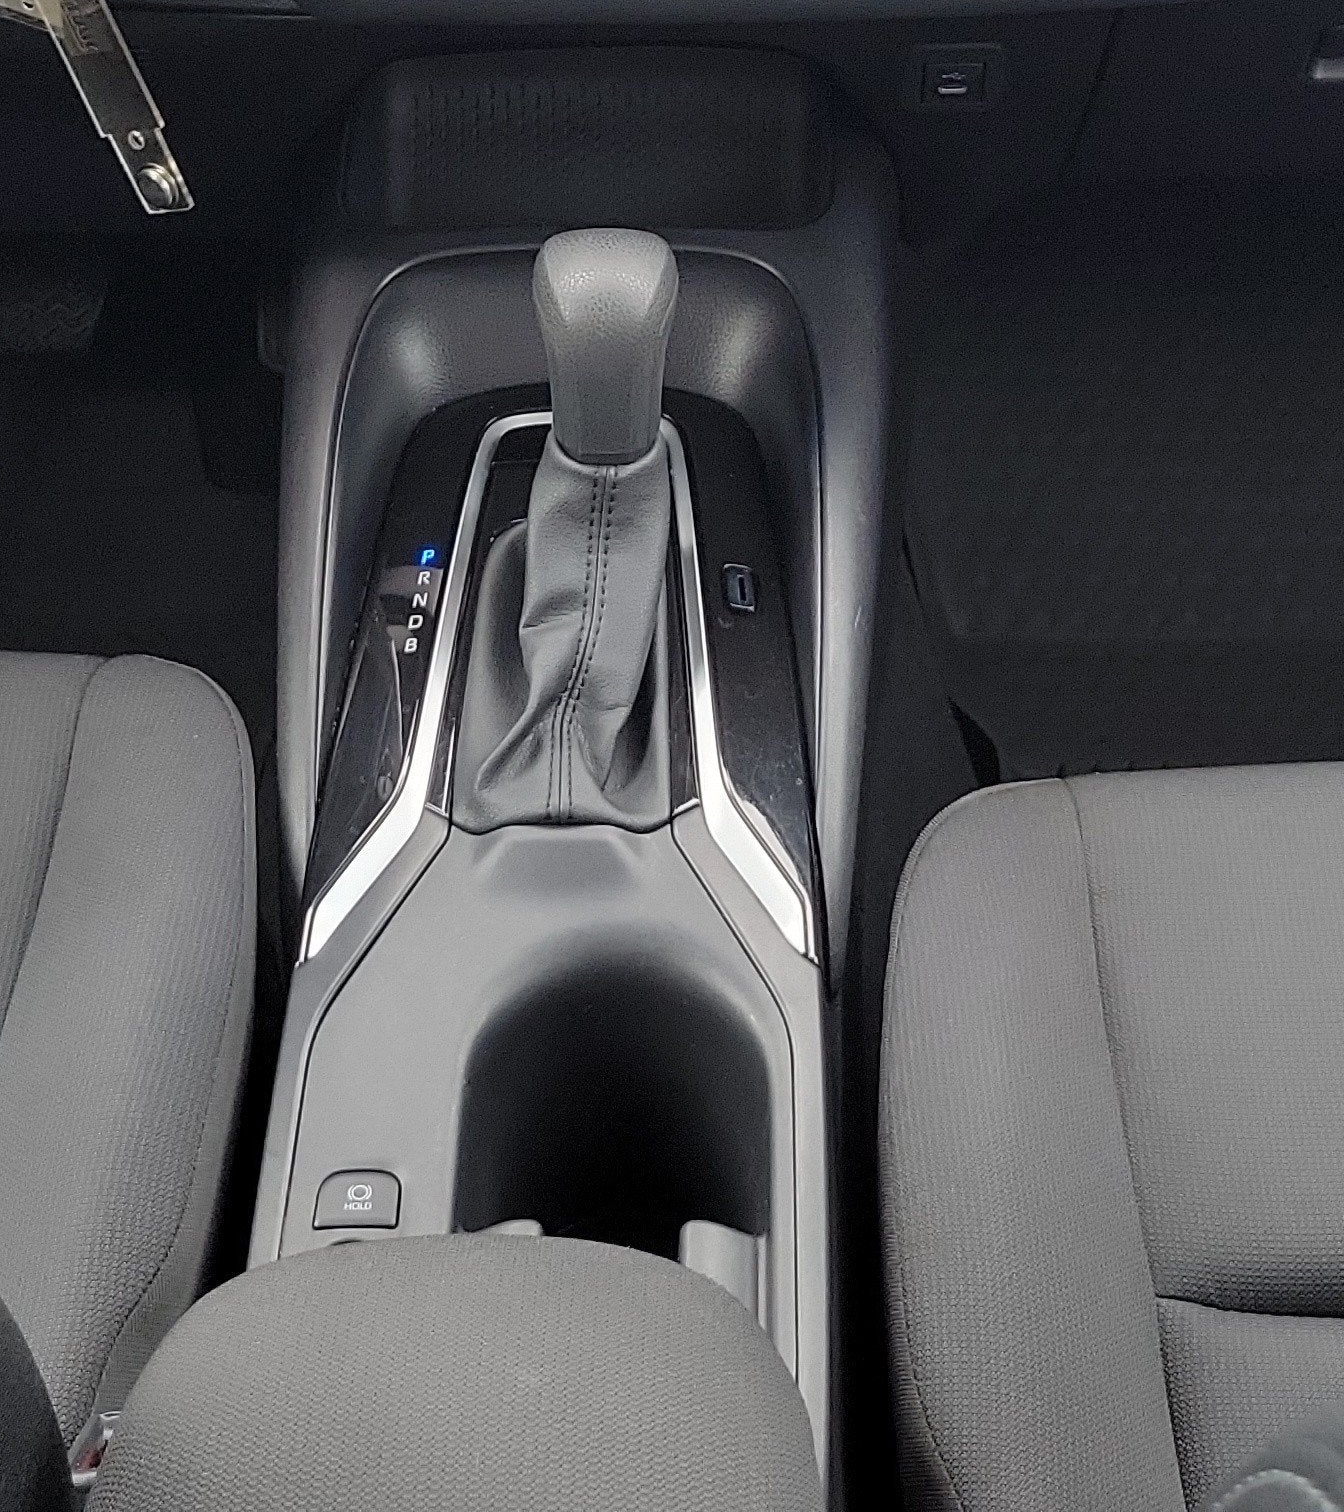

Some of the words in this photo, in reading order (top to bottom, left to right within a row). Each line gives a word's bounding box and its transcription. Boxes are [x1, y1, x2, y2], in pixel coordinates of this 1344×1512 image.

[420, 549, 435, 565] P
[417, 571, 431, 585] R
[412, 592, 428, 608] N
[408, 614, 424, 630] D
[404, 637, 418, 653] B
[344, 1202, 372, 1210] HOLD
